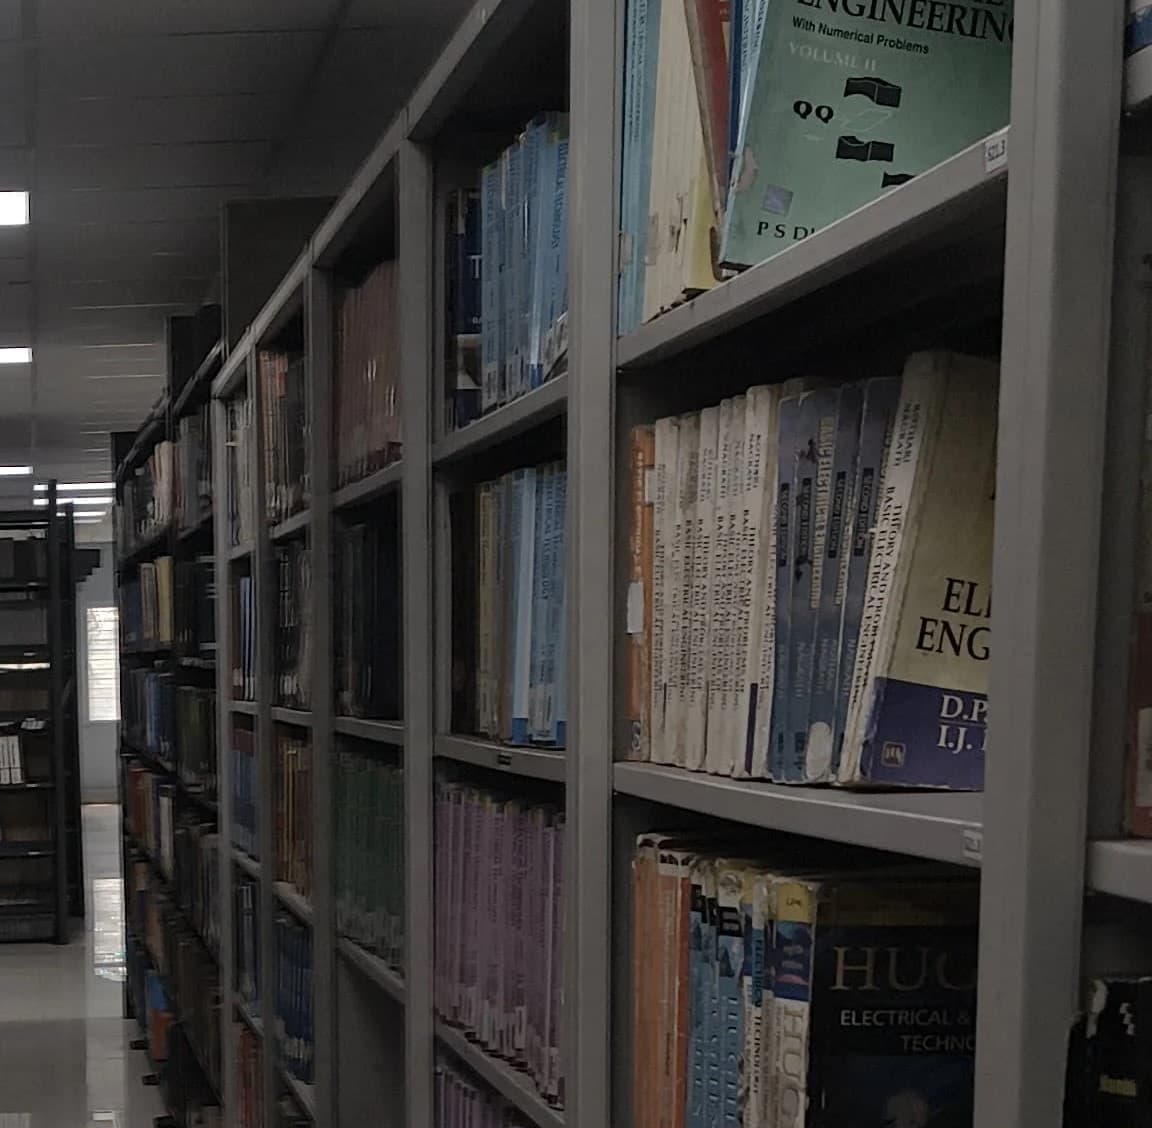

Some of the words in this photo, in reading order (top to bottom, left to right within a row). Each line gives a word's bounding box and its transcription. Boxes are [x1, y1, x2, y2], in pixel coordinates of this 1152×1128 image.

[792, 16, 816, 34] With
[817, 23, 874, 45] Numerical
[875, 33, 930, 55] Problems
[797, 0, 1013, 42] NGINEERIN
[788, 40, 858, 69] VOLUME
[756, 220, 769, 236] P
[774, 223, 786, 239] S
[880, 485, 897, 522] BASIC
[885, 503, 904, 557] THEORY
[867, 529, 888, 610] ELECTRICAL
[879, 562, 891, 594] AND
[839, 1008, 953, 1028] ELECTRICAL
